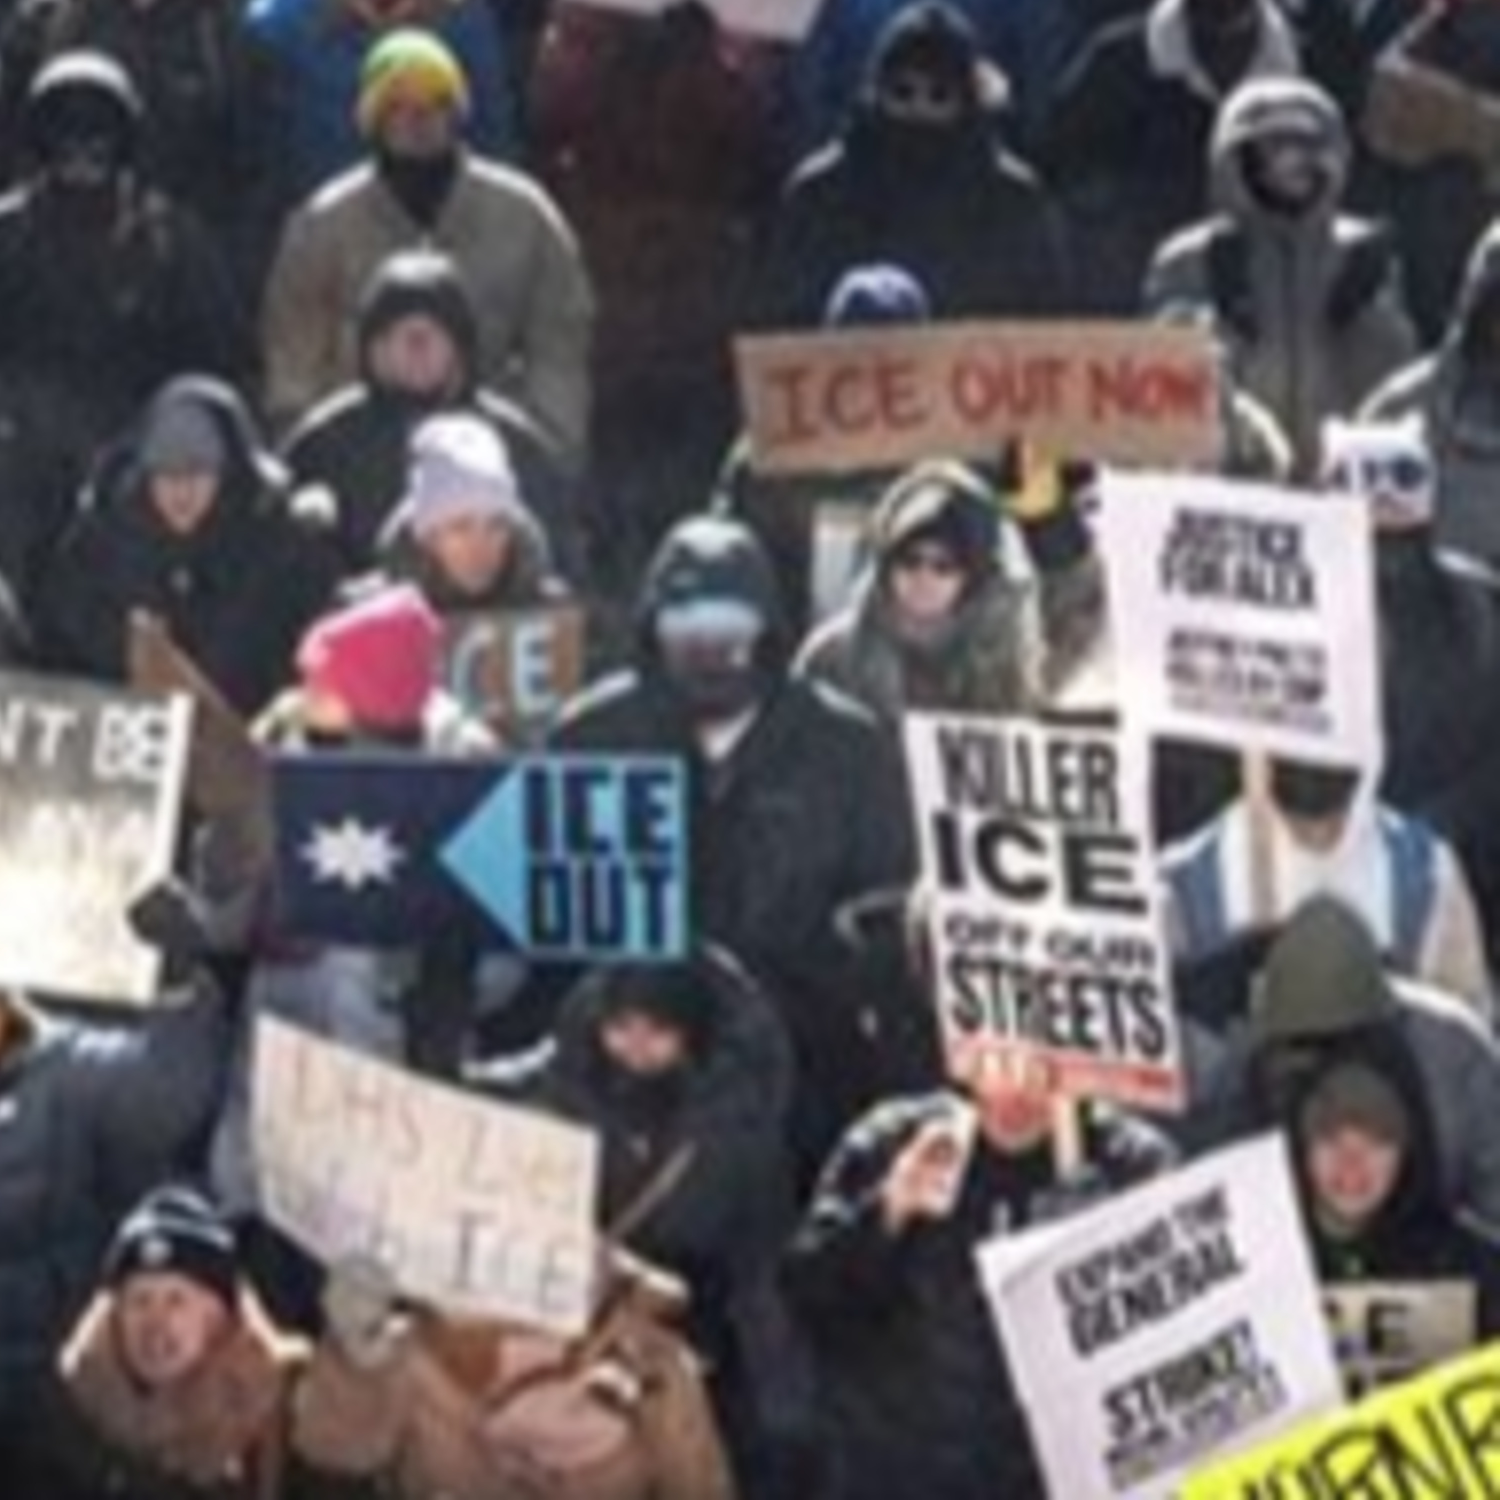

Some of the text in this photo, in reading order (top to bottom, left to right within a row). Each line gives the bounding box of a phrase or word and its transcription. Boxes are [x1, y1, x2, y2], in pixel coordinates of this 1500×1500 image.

[766, 349, 1213, 444] ICE OUT NOW
[451, 614, 554, 716] CE
[93, 702, 172, 781] BE
[936, 723, 1119, 828] KILLER
[526, 765, 676, 857] ICE
[530, 861, 672, 949] OUT
[932, 810, 1149, 916] ICE
[945, 913, 1157, 971] OFF OUR
[949, 951, 1167, 1060] STREETS
[1065, 1227, 1247, 1358] GENERAL
